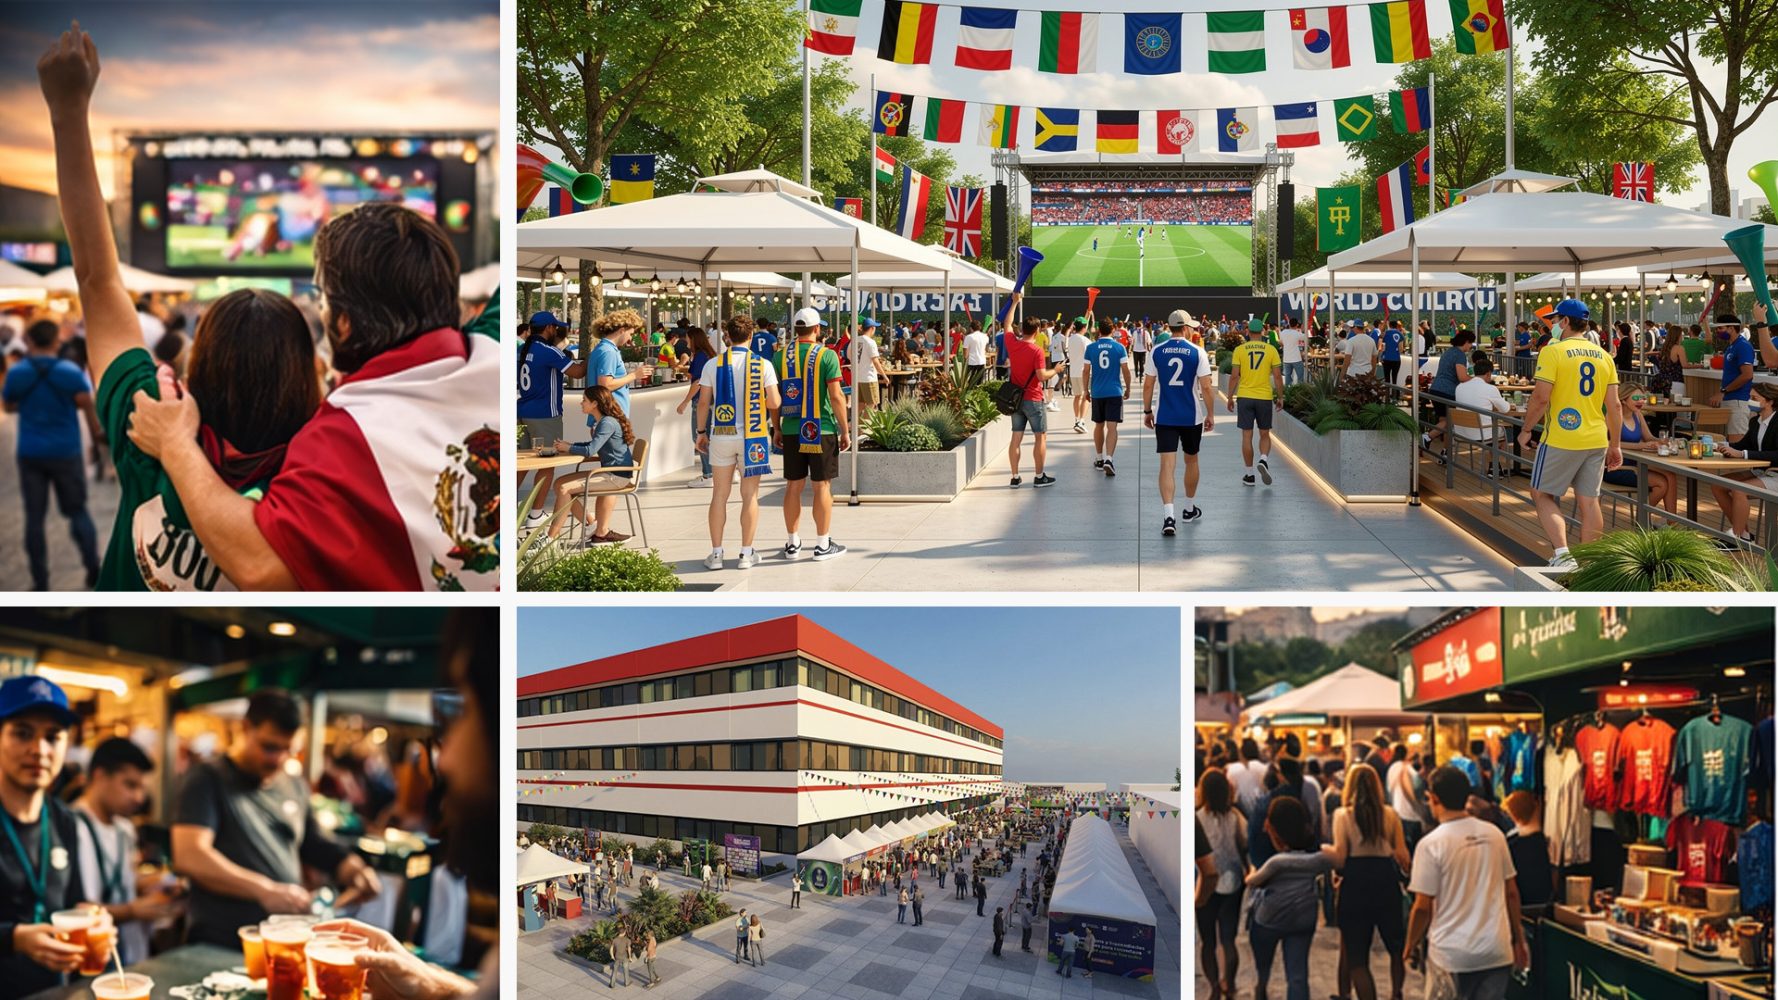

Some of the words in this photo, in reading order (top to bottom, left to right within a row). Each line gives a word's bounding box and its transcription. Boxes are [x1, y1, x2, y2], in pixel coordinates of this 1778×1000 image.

[1288, 292, 1379, 311] WORLD
[1099, 350, 1110, 369] 6
[1248, 351, 1265, 370] 17
[520, 363, 531, 391] 8
[1167, 357, 1184, 386] 2
[1579, 361, 1596, 396] 8
